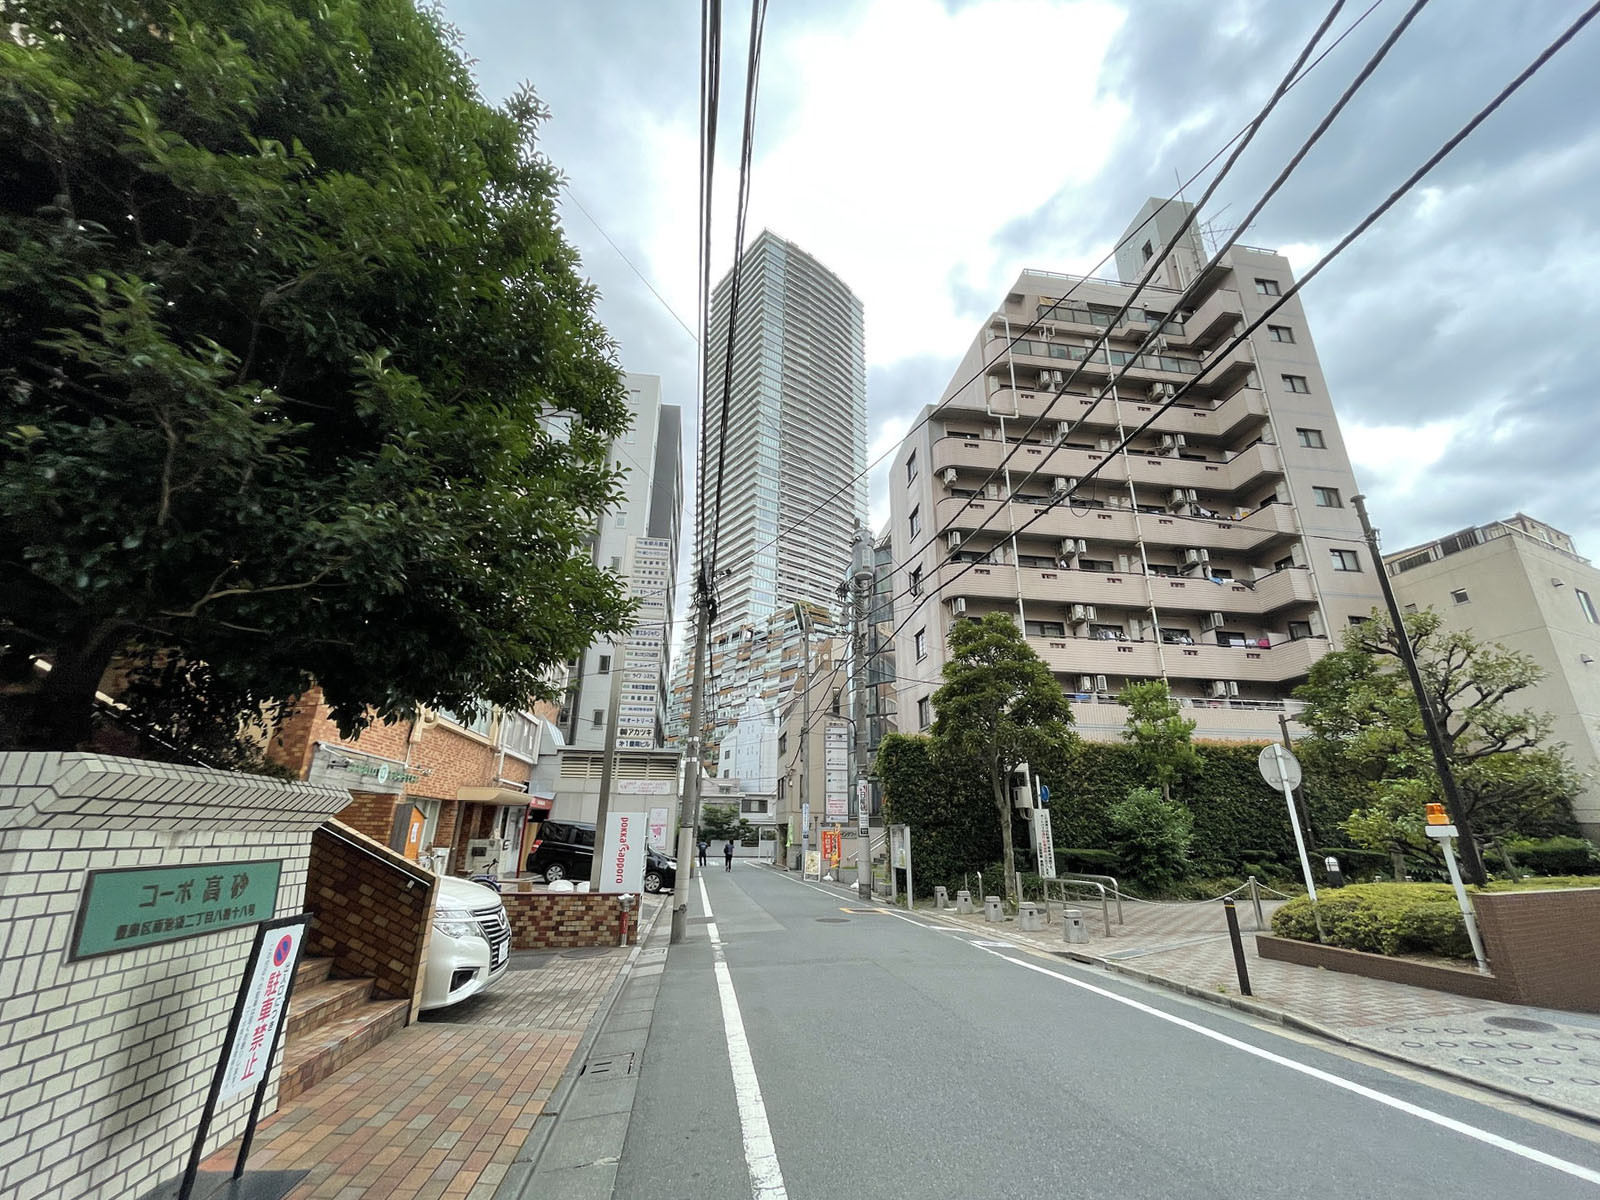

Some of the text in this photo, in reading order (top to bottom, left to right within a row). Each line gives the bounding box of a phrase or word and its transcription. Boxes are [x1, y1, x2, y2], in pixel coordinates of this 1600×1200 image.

[616, 847, 627, 884] sapporo
[138, 871, 250, 908] コーポ高砂
[241, 970, 282, 1081] 駐車禁止
